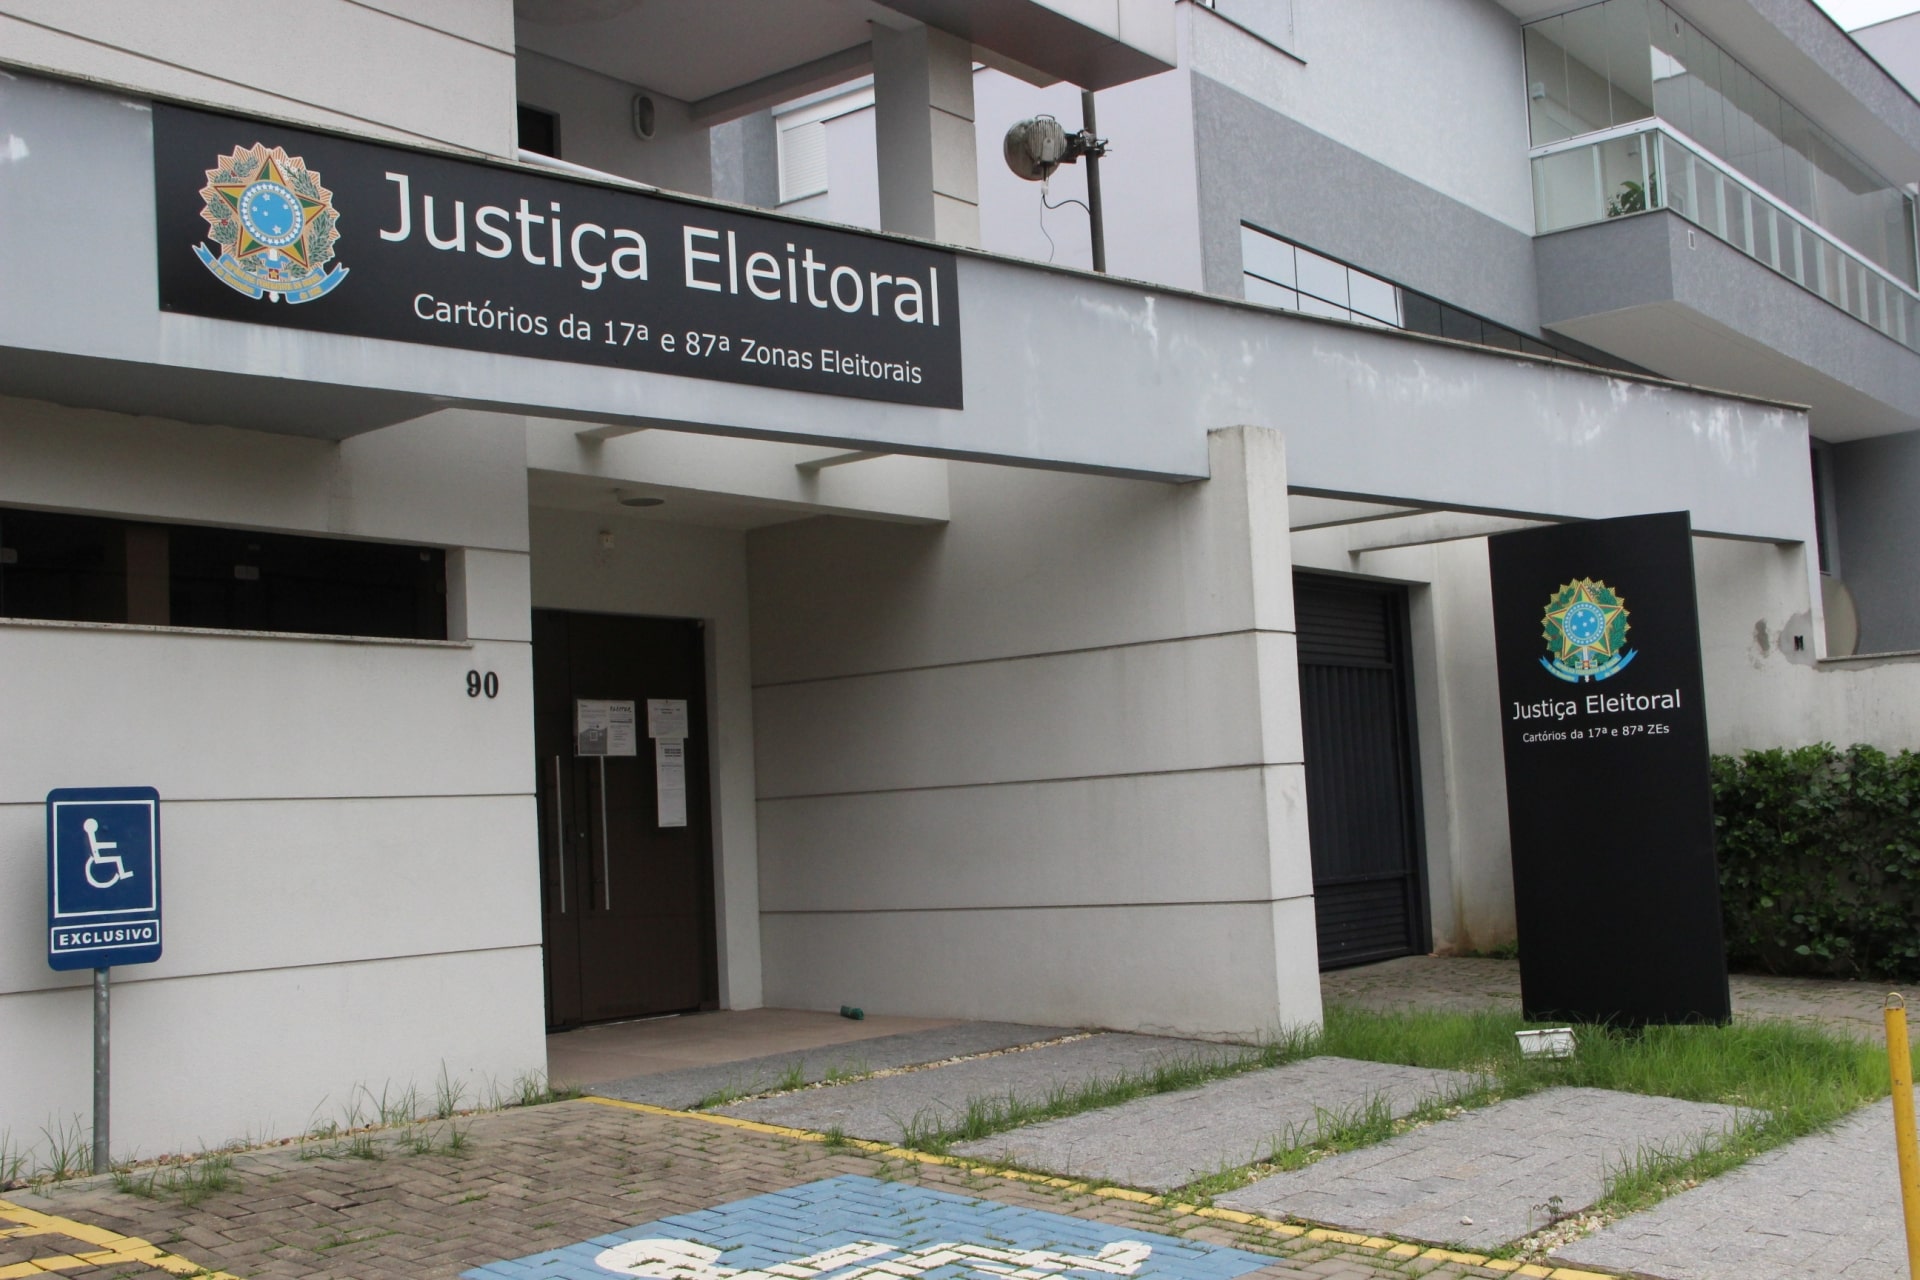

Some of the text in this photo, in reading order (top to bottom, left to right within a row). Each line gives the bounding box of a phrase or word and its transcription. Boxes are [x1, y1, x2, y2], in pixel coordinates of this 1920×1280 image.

[379, 171, 941, 327] Justiça Eleitoral
[413, 293, 548, 336] Cartórios
[559, 313, 591, 341] da
[660, 333, 675, 353] e
[740, 338, 813, 370] Zonas
[820, 348, 922, 384] Eleitorais
[466, 669, 499, 699] 90
[1512, 688, 1681, 721] Justiça Eleitoral
[1522, 730, 1567, 743] Cartórios
[1570, 729, 1584, 740] da
[1610, 728, 1618, 737] e
[1647, 723, 1670, 735] ZEs
[59, 927, 153, 946] EXCLUSIVO
